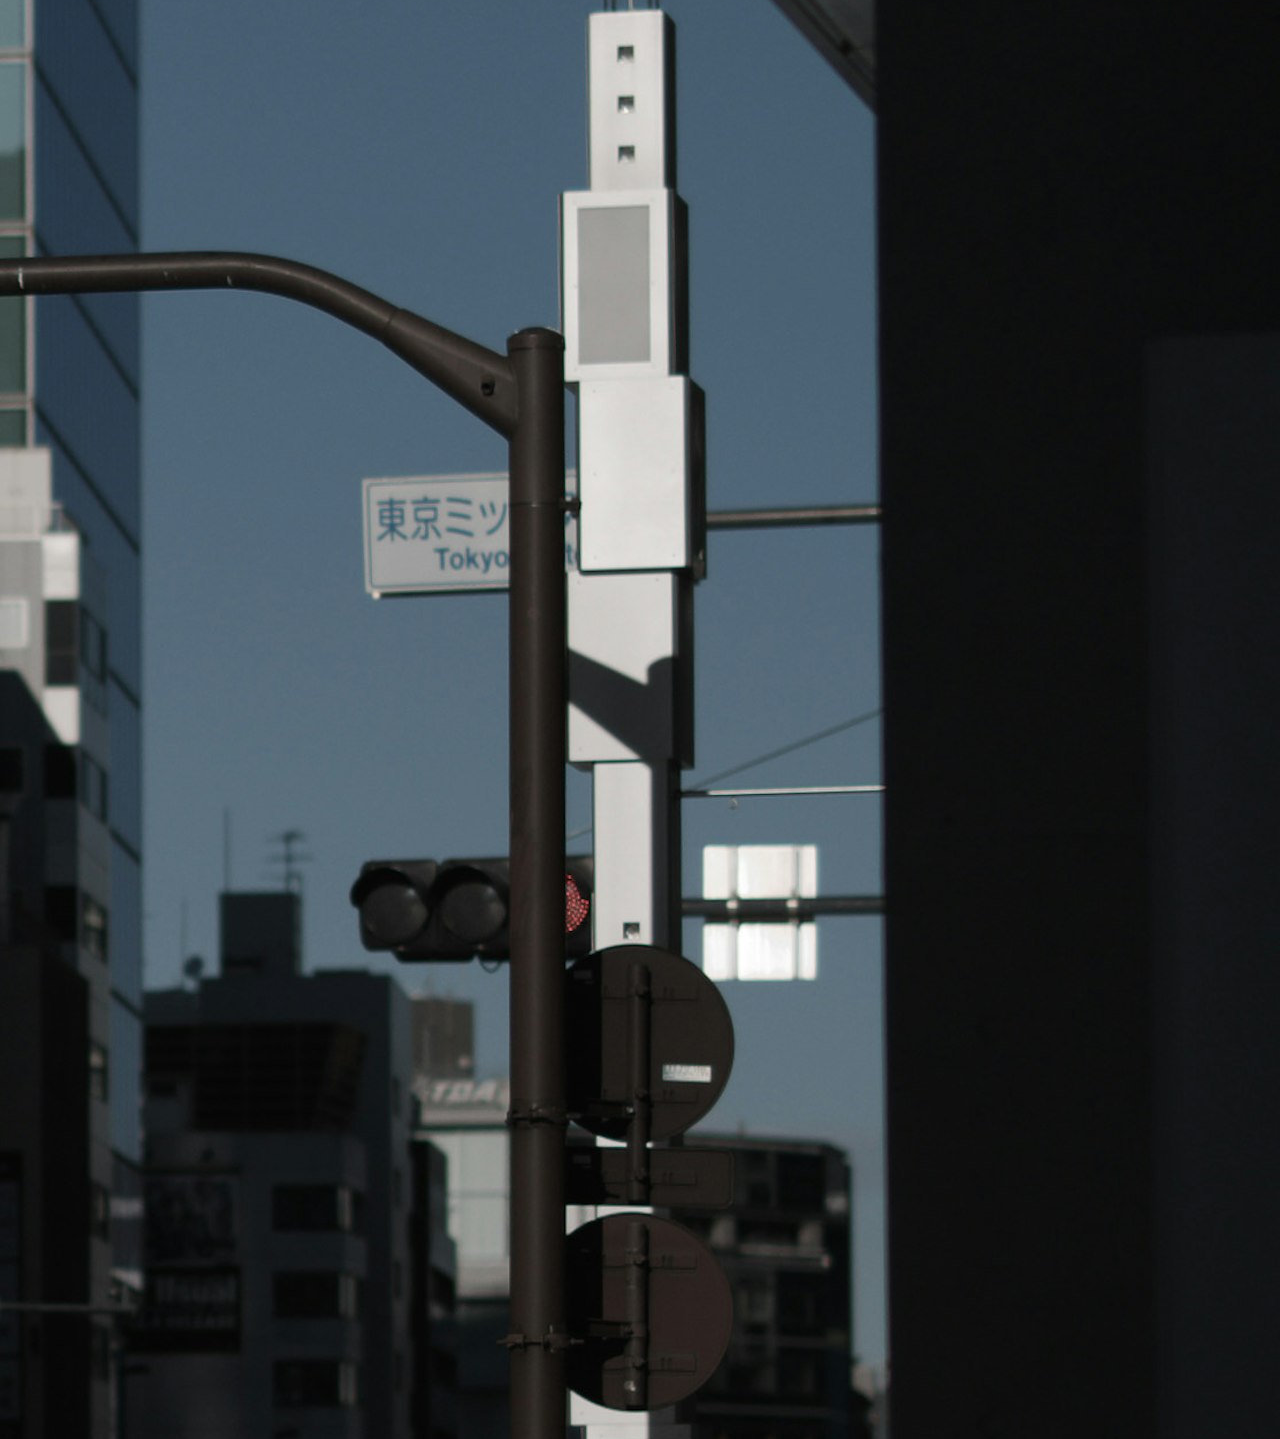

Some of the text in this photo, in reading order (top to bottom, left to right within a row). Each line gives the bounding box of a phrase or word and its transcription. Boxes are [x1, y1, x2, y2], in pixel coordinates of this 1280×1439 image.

[376, 496, 509, 543] 東京ミッ
[434, 547, 510, 574] Tokyo
